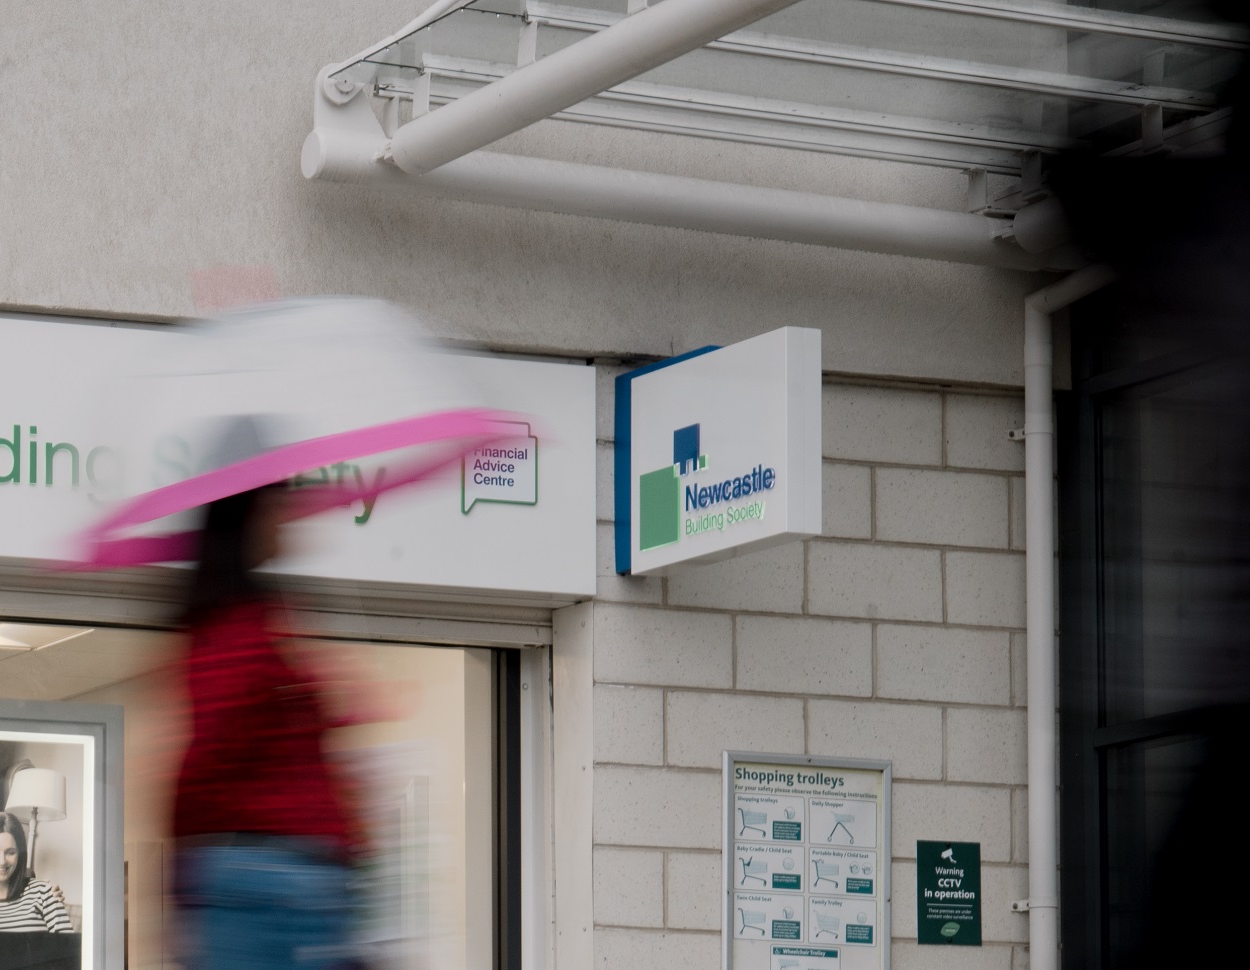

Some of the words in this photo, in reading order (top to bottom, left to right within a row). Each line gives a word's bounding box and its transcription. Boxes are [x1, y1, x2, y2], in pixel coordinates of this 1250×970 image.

[473, 446, 528, 460] Financial
[473, 459, 515, 473] Advice
[473, 472, 515, 487] Centre
[685, 463, 775, 512] Newcastle
[685, 512, 725, 536] Building
[726, 501, 765, 524] Society
[735, 767, 794, 786] Shopping
[796, 772, 845, 790] trolleys
[822, 789, 847, 799] following
[847, 791, 878, 799] instructions
[935, 867, 964, 877] Warning
[938, 878, 961, 887] CCTV
[924, 888, 932, 897] in
[935, 890, 975, 900] operation
[782, 948, 810, 956] Wheelchair
[810, 949, 826, 958] Trolley
